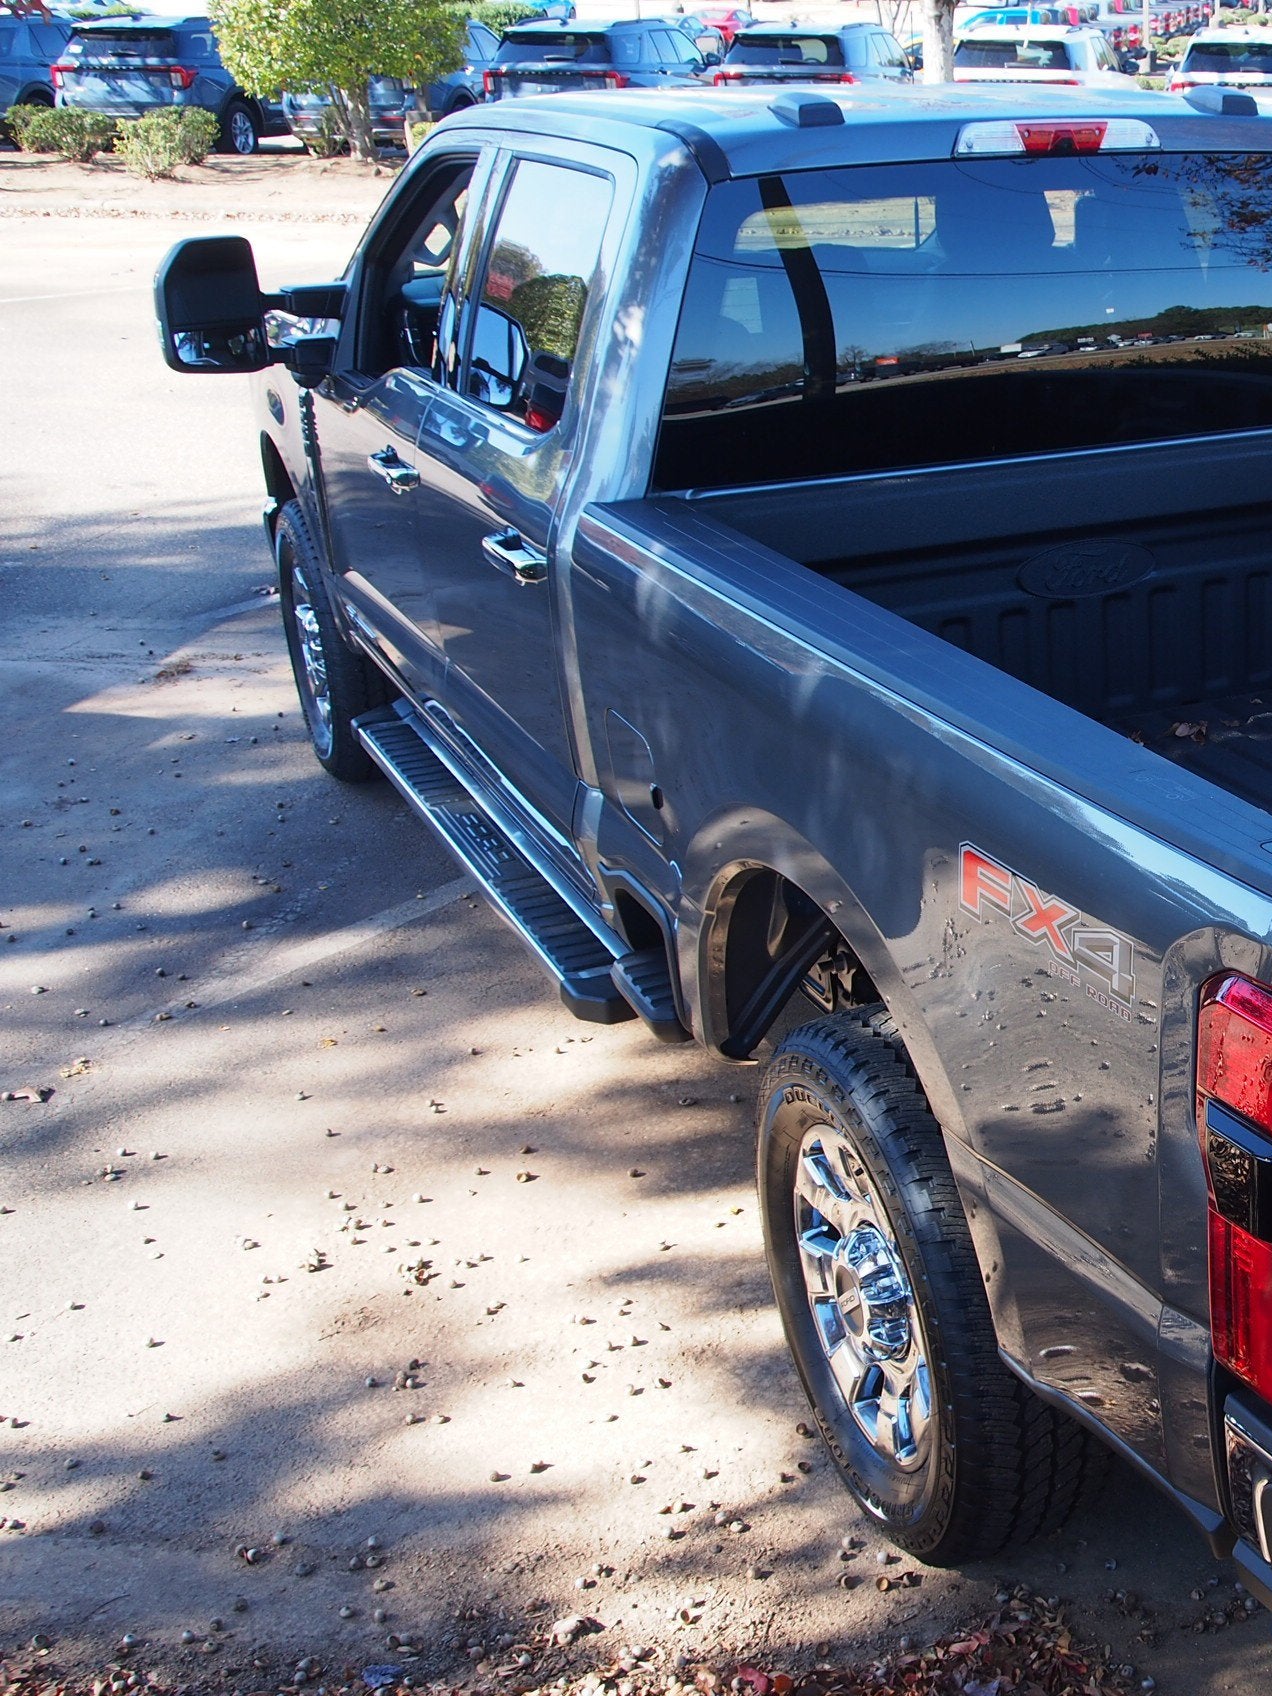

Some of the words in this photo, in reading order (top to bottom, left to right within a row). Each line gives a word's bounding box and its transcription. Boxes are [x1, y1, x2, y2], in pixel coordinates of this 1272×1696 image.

[958, 840, 1136, 1007] FX4
[1048, 959, 1081, 988] OFF
[1085, 983, 1132, 1023] ROAD
